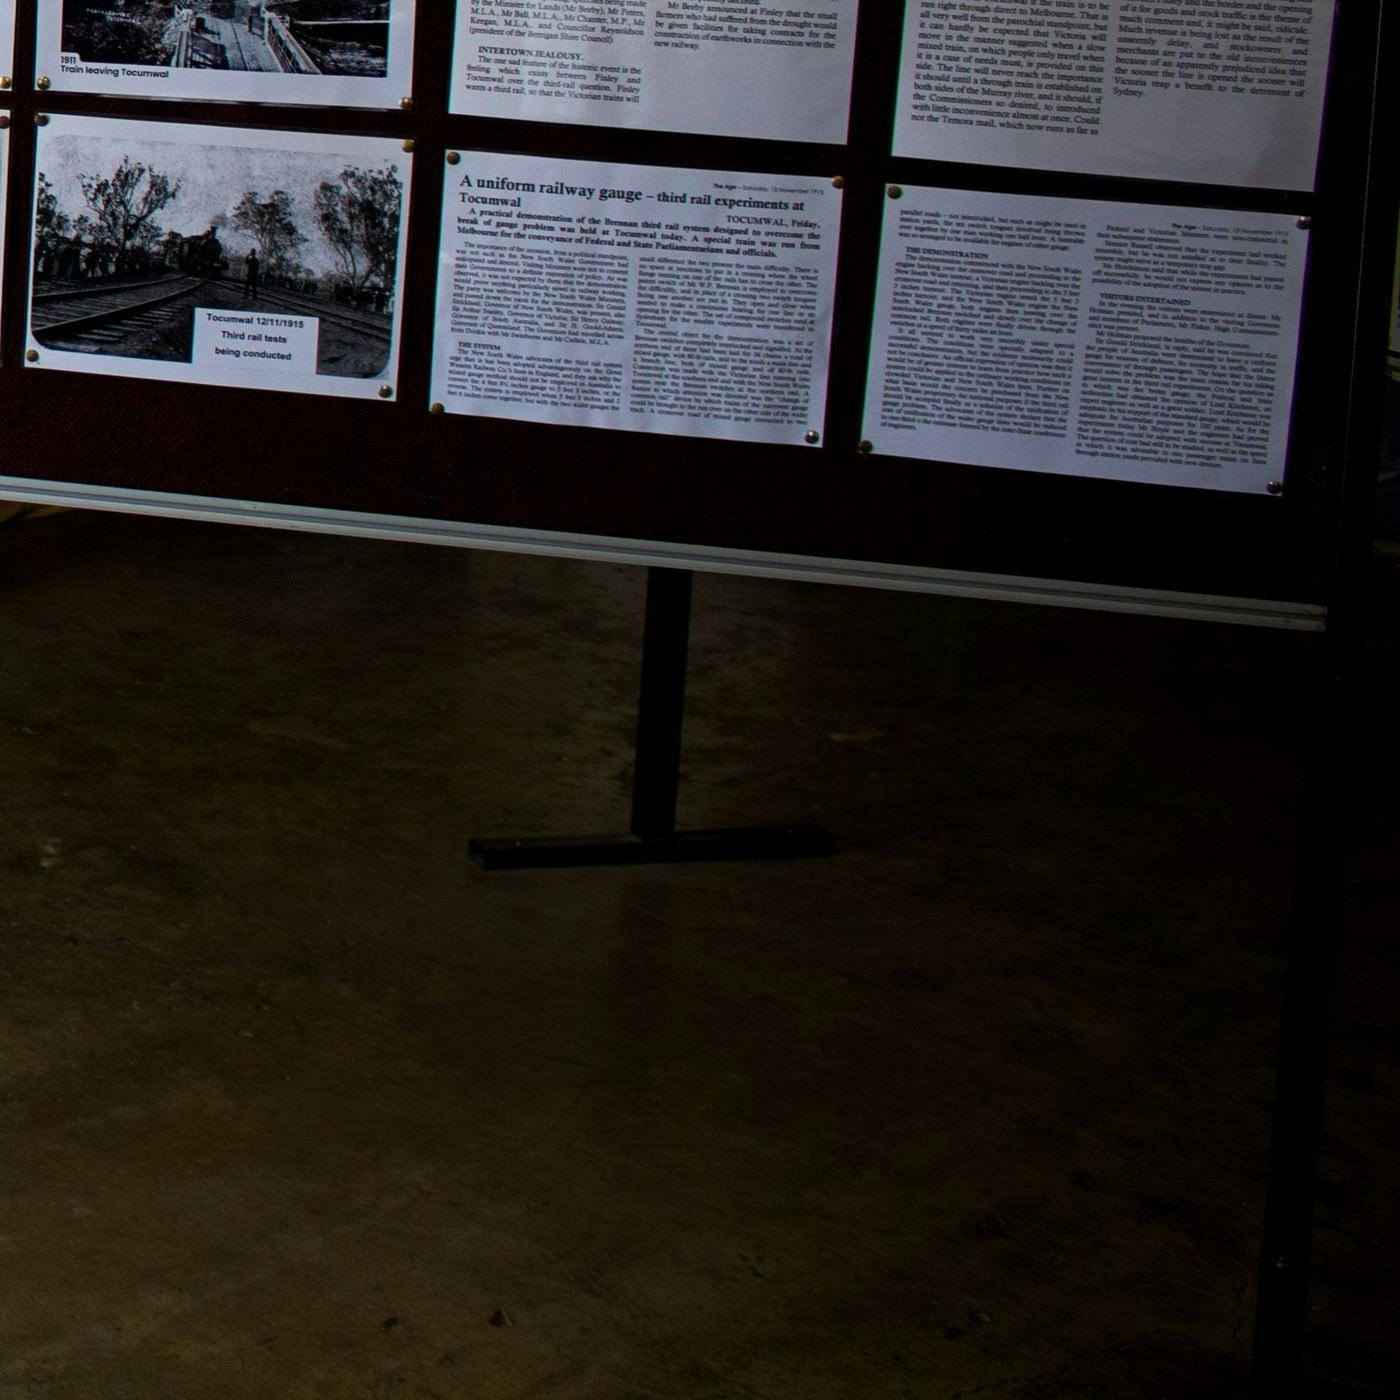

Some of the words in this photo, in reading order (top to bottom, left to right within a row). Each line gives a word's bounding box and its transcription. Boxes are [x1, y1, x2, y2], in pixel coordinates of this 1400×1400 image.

[61, 65, 83, 74] Train
[85, 67, 119, 77] leaving
[121, 68, 169, 78] Tocumwal
